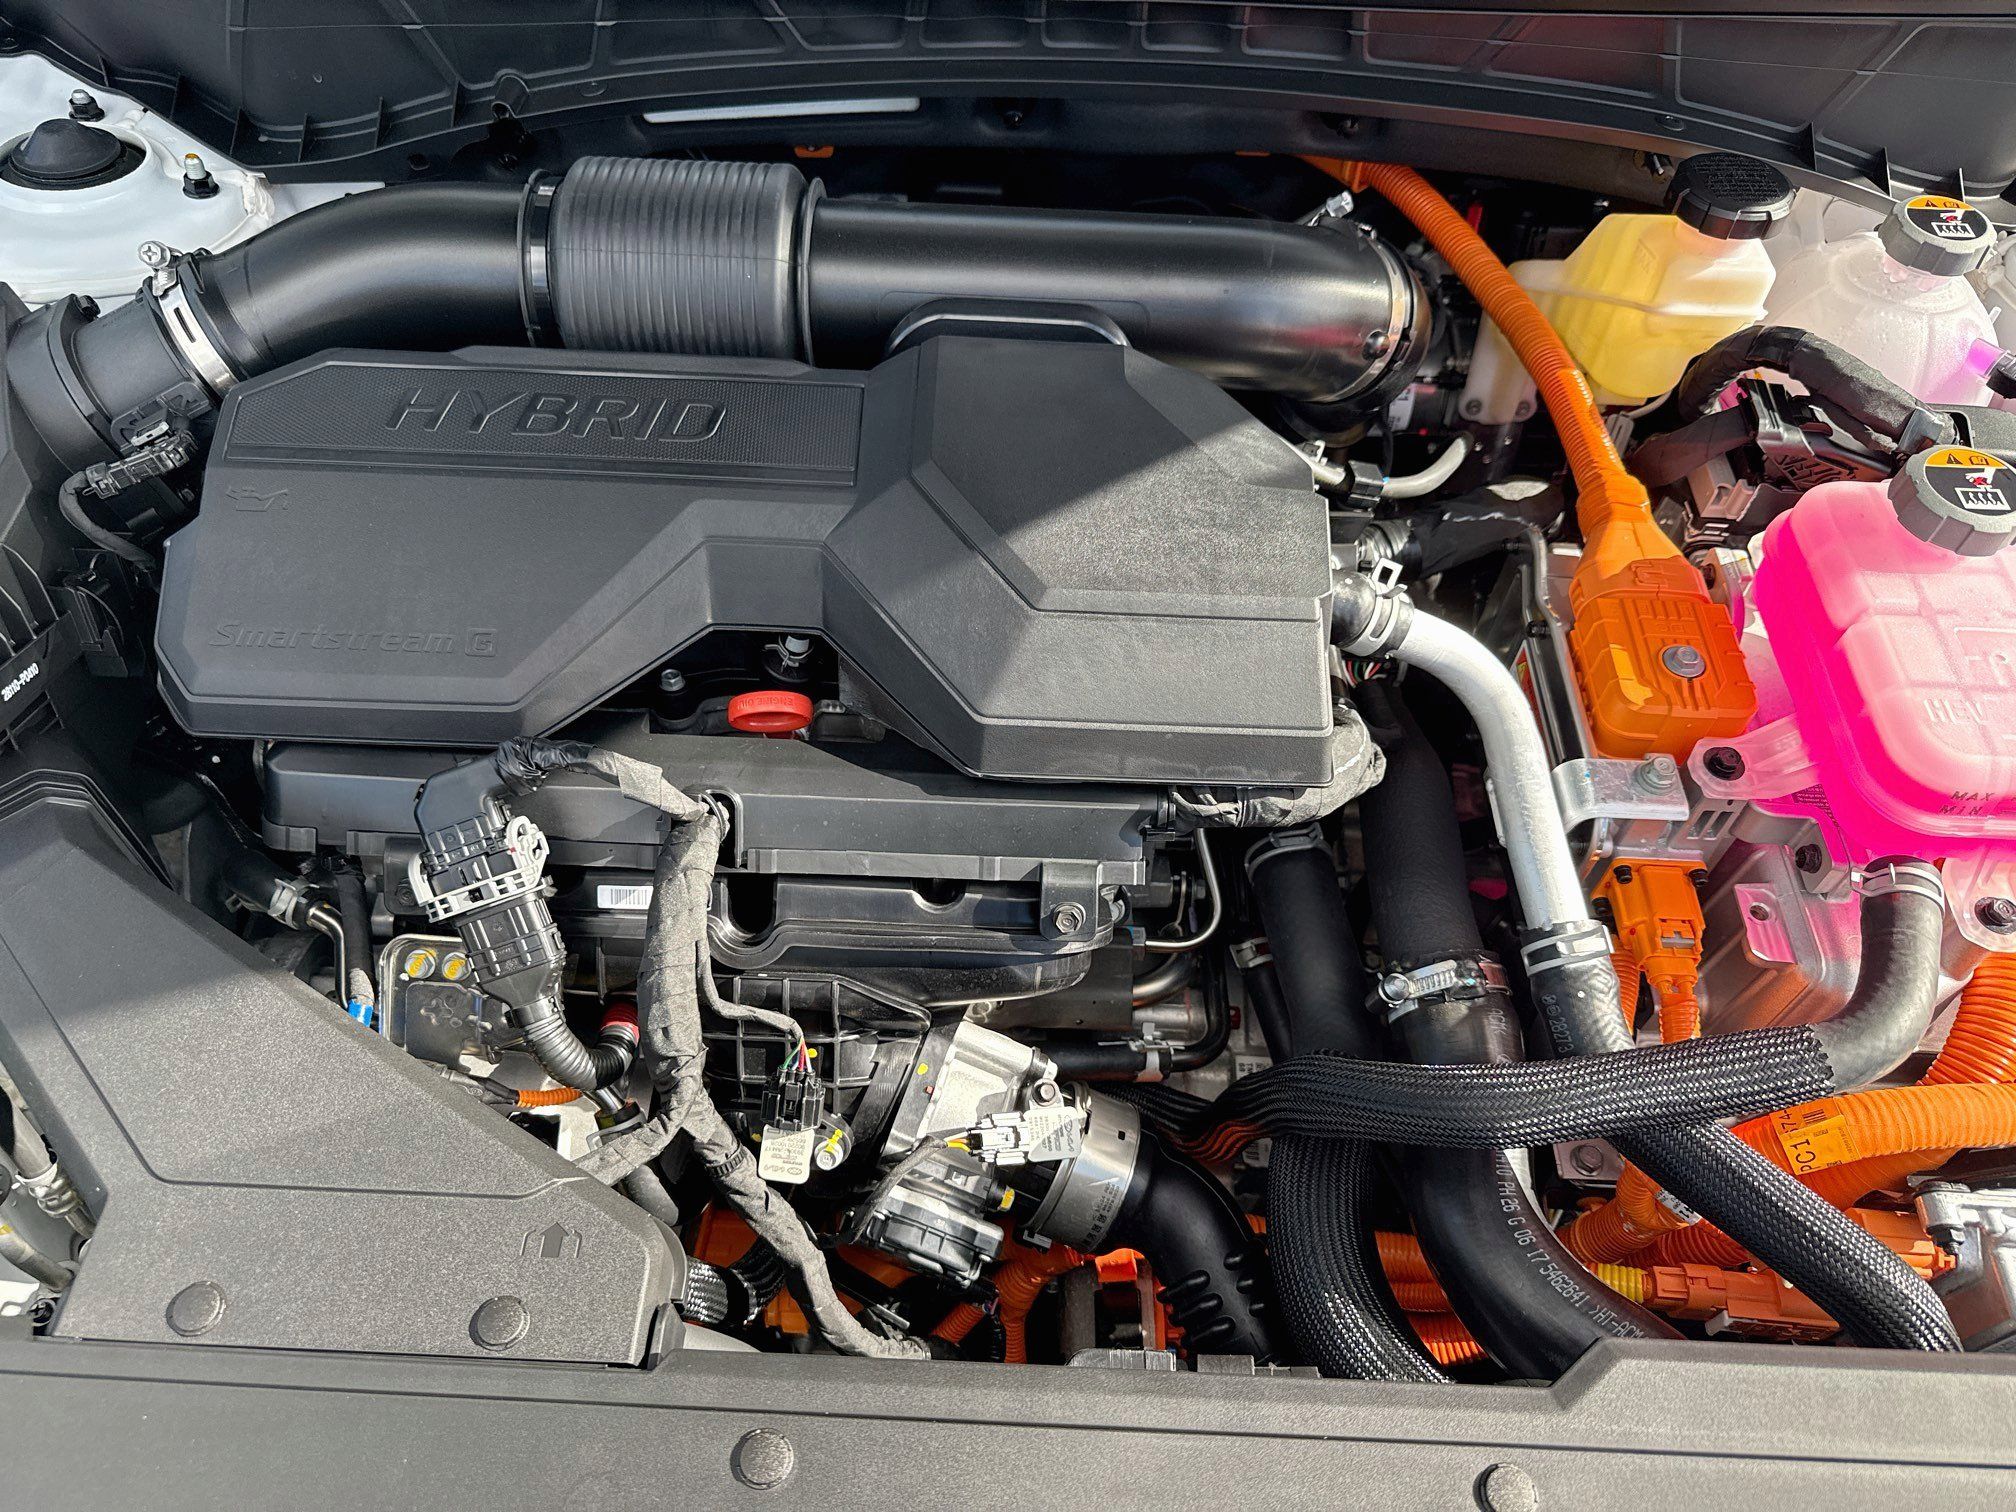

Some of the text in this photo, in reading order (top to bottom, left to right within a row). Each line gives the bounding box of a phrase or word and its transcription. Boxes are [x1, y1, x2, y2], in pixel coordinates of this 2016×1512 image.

[384, 386, 728, 443] HYBRID
[208, 622, 496, 656] Smartstream G
[1938, 804, 1984, 815] MIN
[1950, 790, 1995, 802] MAX
[1549, 1017, 1574, 1053] 28273
[1790, 1138, 1822, 1172] PC1
[1513, 1228, 1537, 1246] 06
[1526, 1248, 1550, 1263] 17
[1538, 1262, 1591, 1308] 5462641
